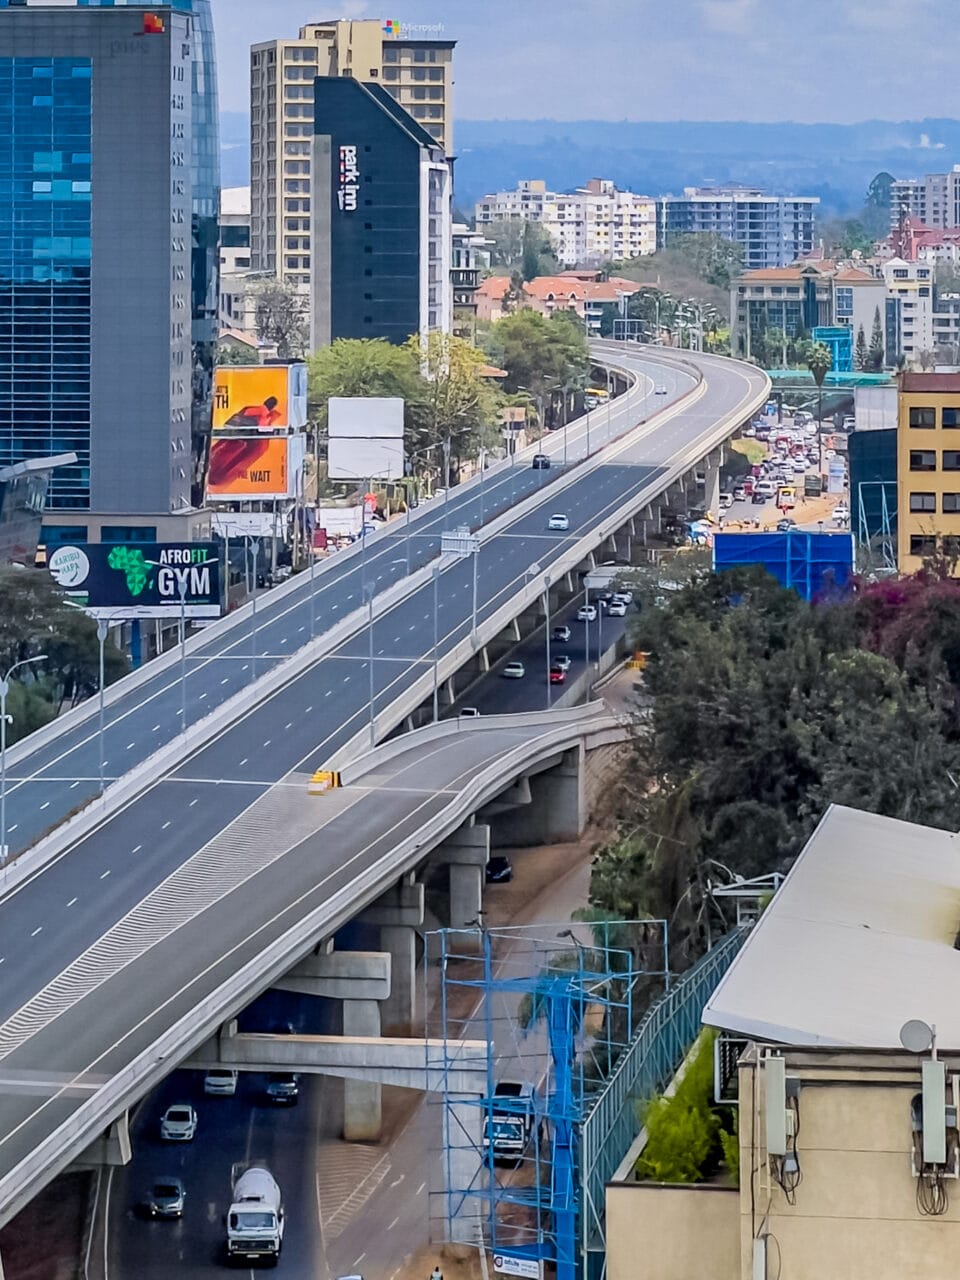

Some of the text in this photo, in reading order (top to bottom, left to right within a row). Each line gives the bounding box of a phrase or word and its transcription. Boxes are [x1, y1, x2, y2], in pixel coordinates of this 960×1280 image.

[401, 22, 445, 32] Microsoft
[339, 145, 360, 183] park
[250, 470, 271, 483] WAIT
[159, 549, 208, 564] AFROFIT
[158, 567, 210, 596] GYM
